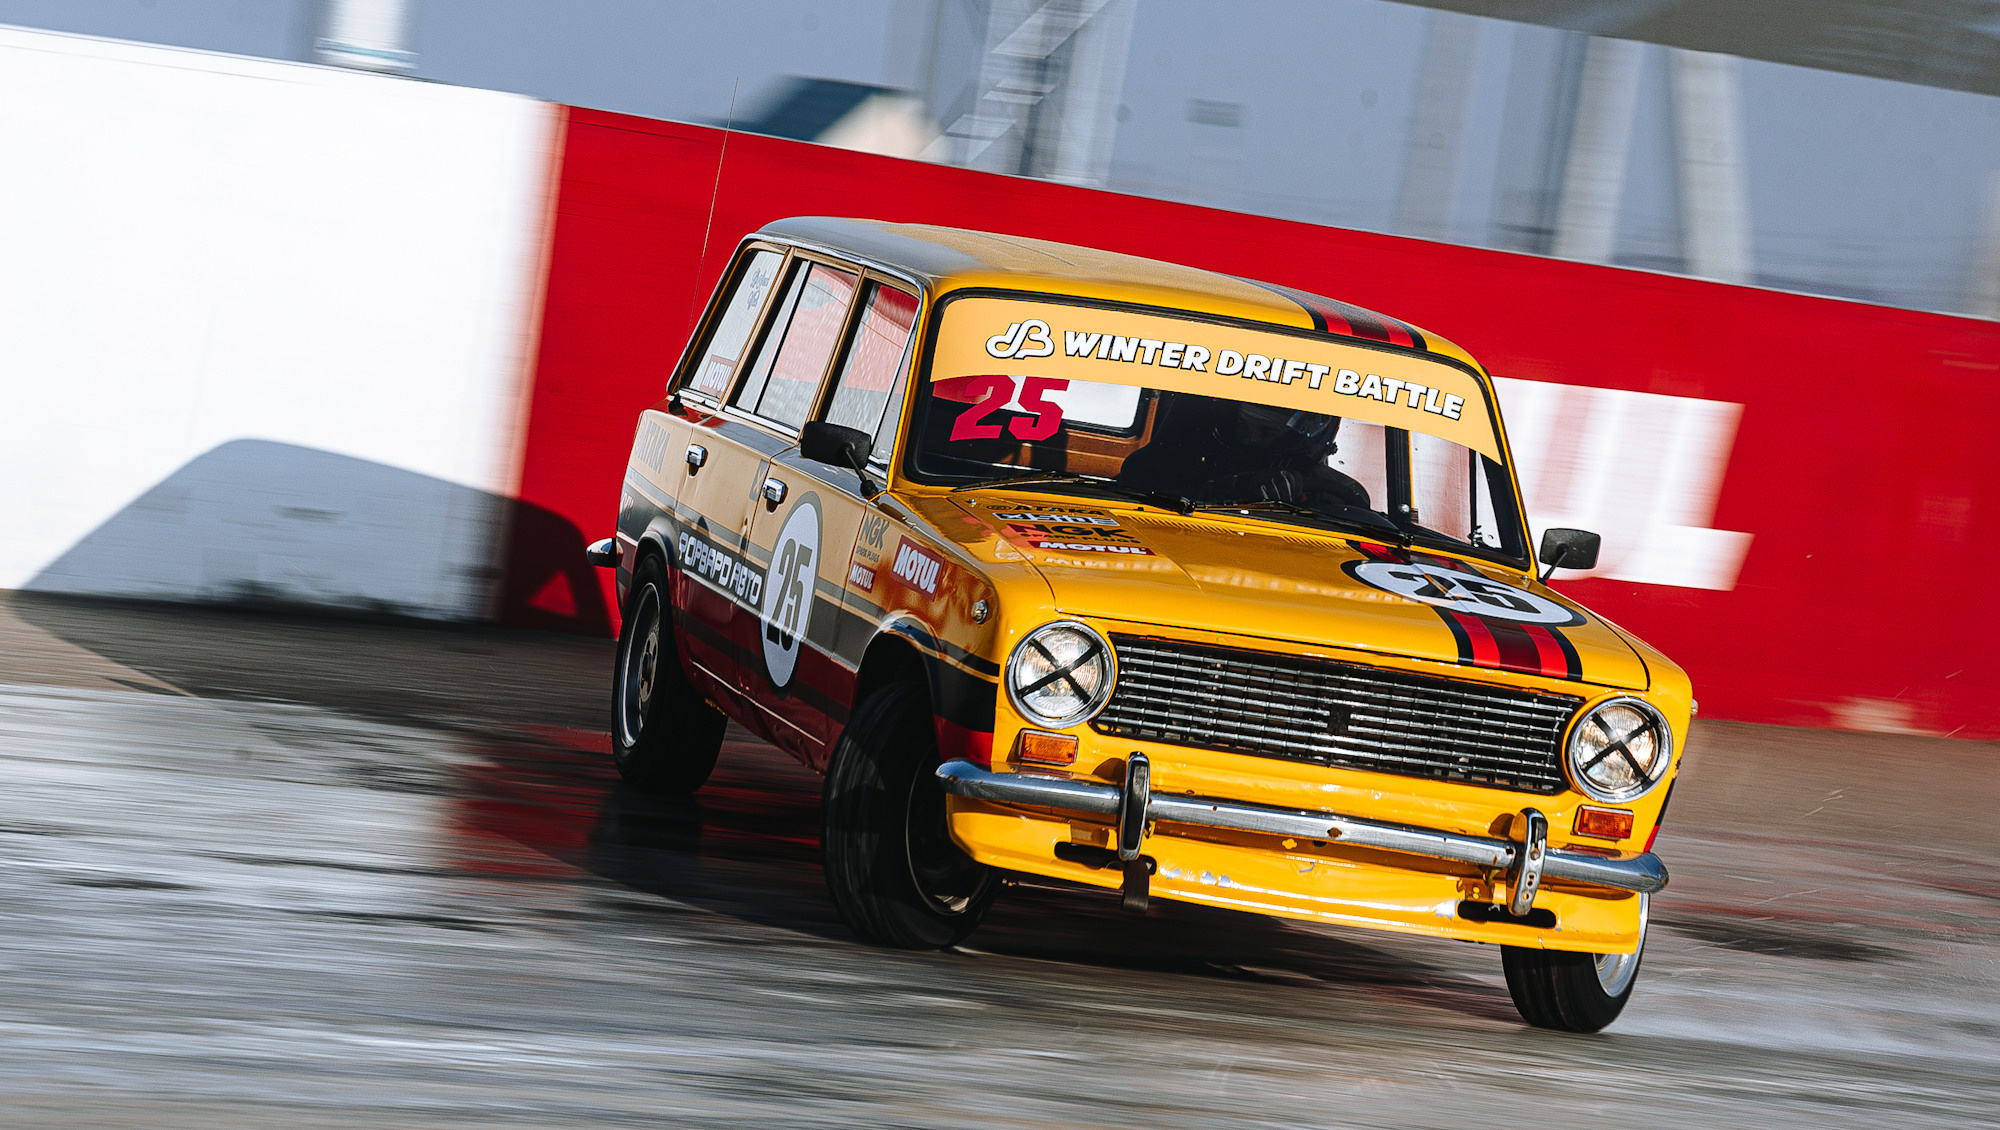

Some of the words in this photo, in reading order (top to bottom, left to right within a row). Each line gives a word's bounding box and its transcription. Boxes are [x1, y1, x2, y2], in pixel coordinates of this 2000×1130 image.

[702, 361, 733, 392] MOTUL
[1064, 330, 1210, 373] WINTER
[1215, 348, 1330, 389] DRIFT
[1334, 369, 1465, 421] BATTLE
[948, 375, 1071, 441] 25
[859, 513, 890, 550] NGK
[1006, 523, 1136, 540] NGK
[1039, 541, 1147, 555] MOTUL
[849, 564, 874, 589] MOTUL
[893, 543, 940, 594] MOTUL
[766, 538, 813, 652] 25
[1388, 571, 1542, 614] 25
